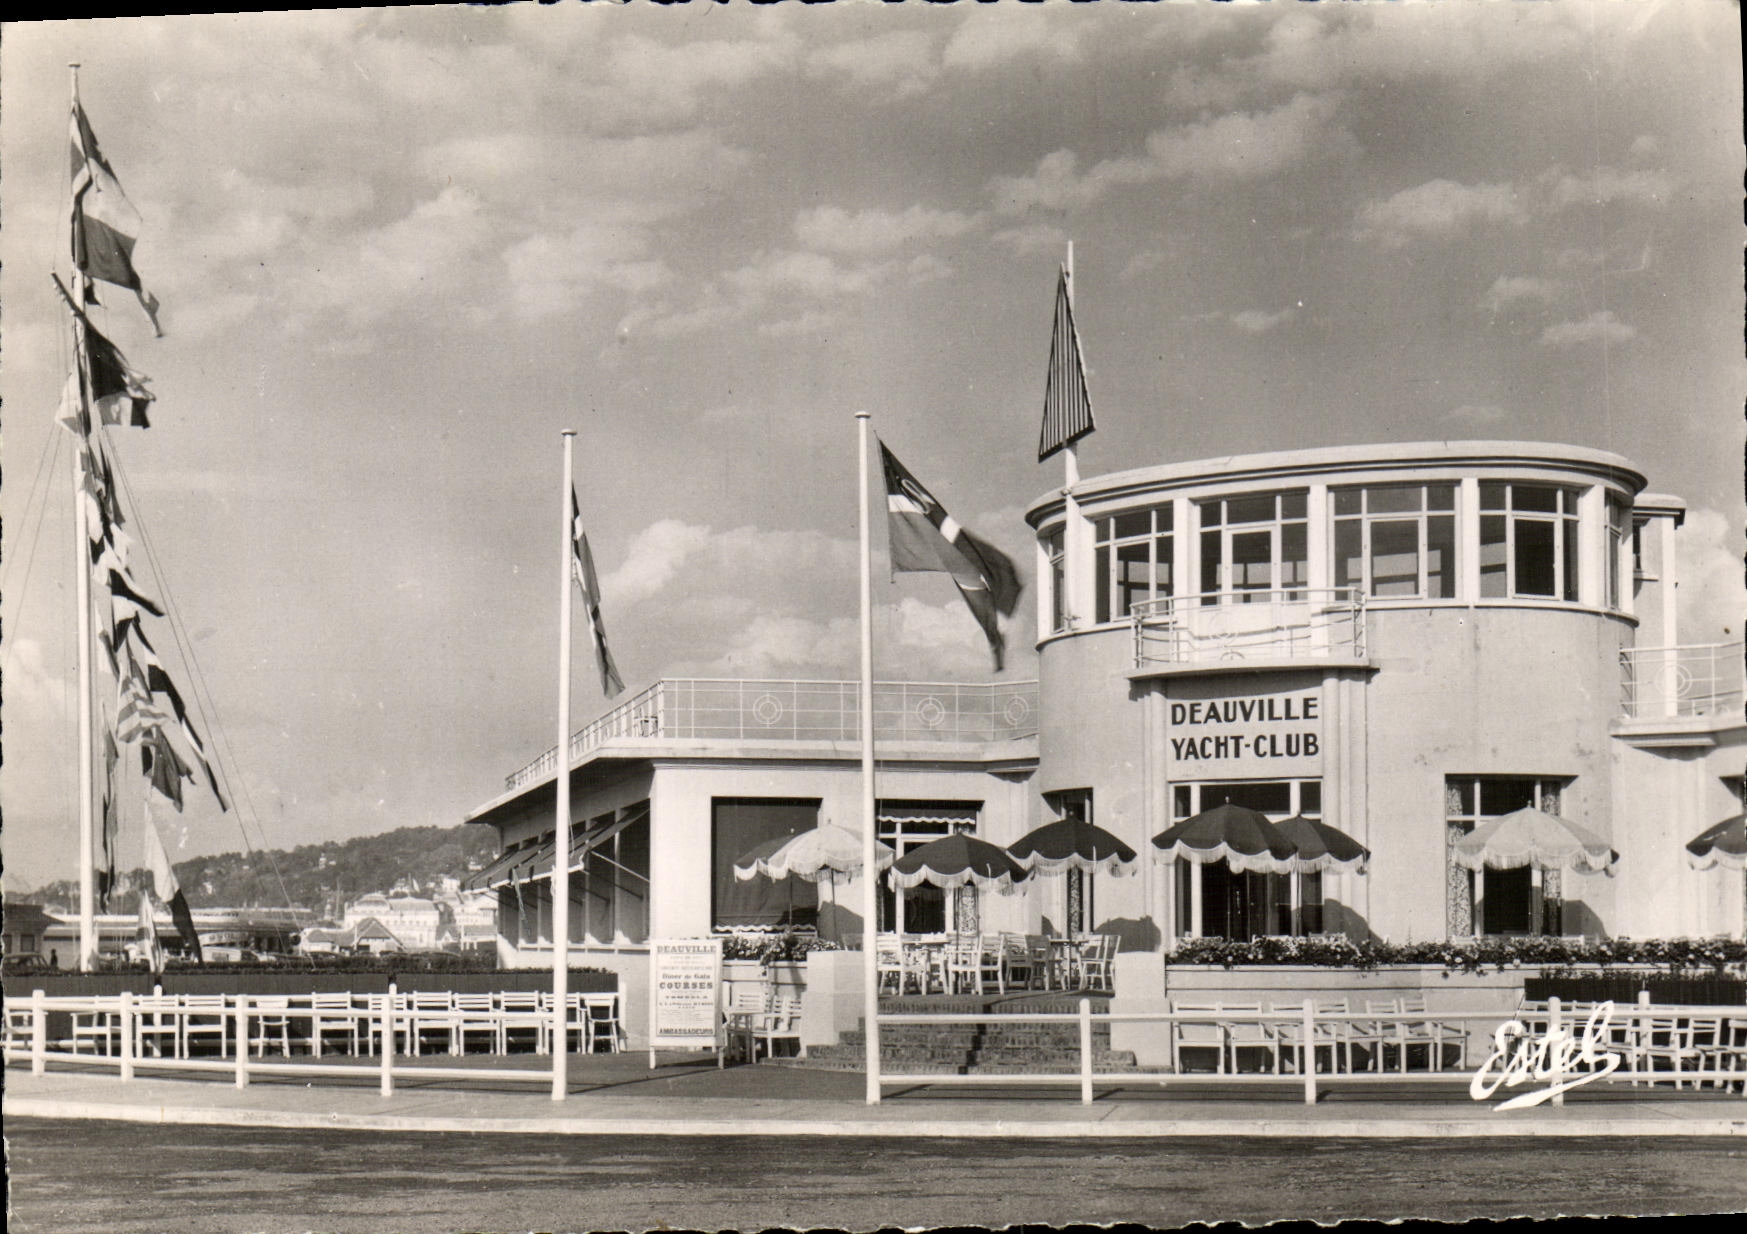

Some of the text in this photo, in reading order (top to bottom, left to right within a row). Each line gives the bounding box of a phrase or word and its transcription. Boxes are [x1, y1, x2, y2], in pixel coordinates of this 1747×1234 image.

[1171, 697, 1318, 725] DEAUVILLE
[1171, 733, 1319, 760] YACHT-CLUB
[657, 945, 716, 953] DEAUVILLE
